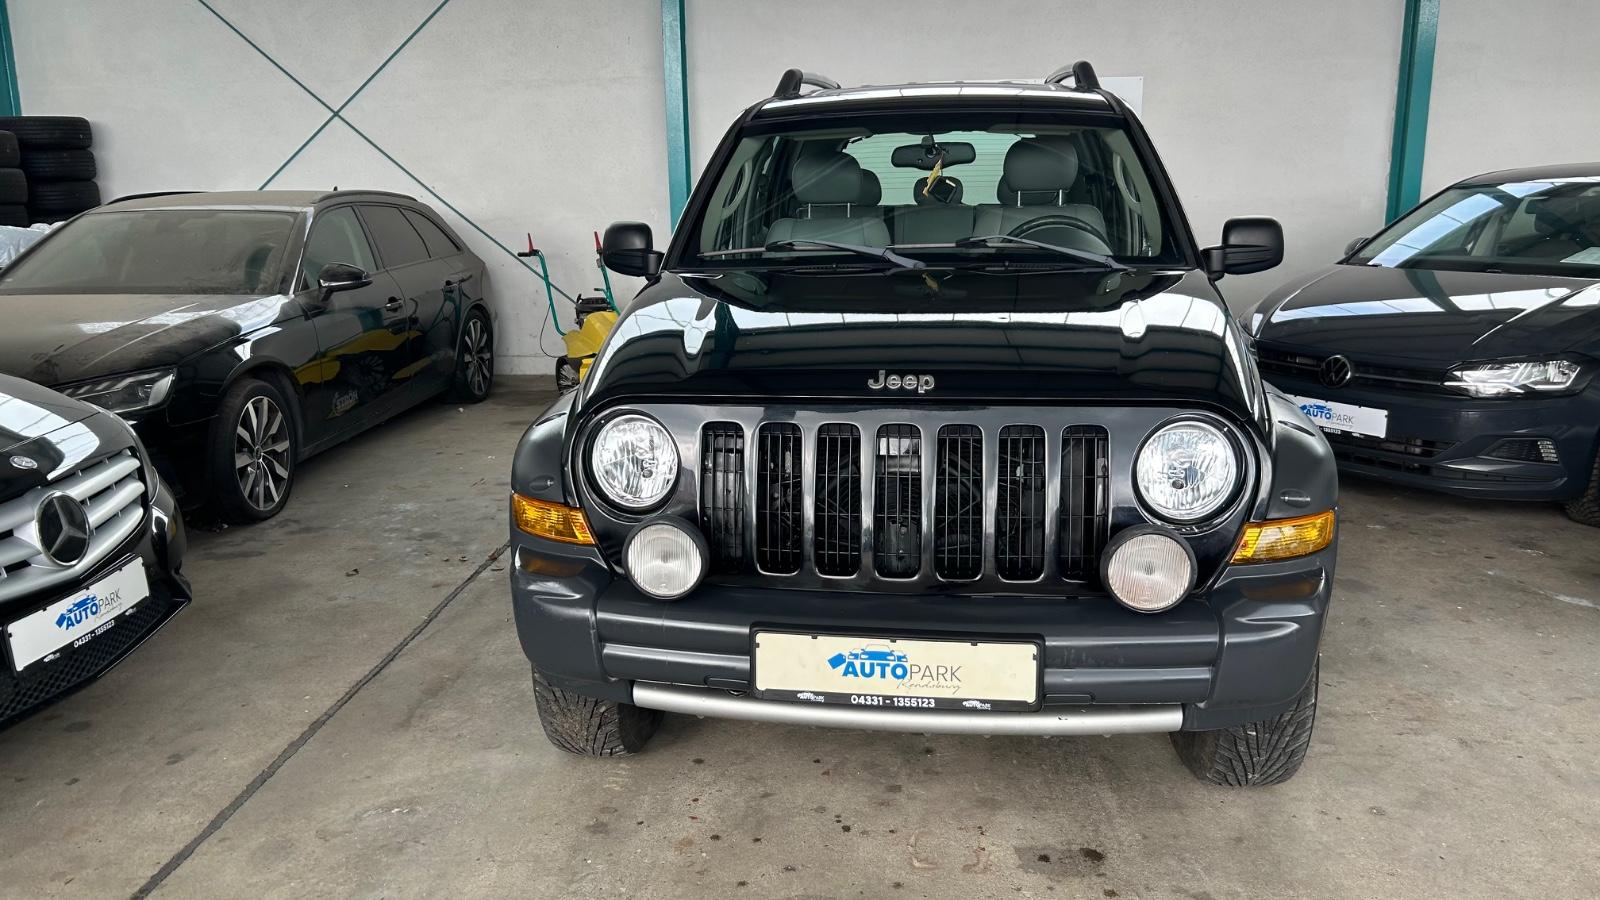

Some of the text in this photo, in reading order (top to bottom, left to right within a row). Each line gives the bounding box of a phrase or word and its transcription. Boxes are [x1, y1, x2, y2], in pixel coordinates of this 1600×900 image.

[868, 369, 935, 394] Jeep
[842, 661, 962, 683] AUTOPARK
[850, 694, 883, 706] 04331
[892, 697, 936, 708] 1355123
